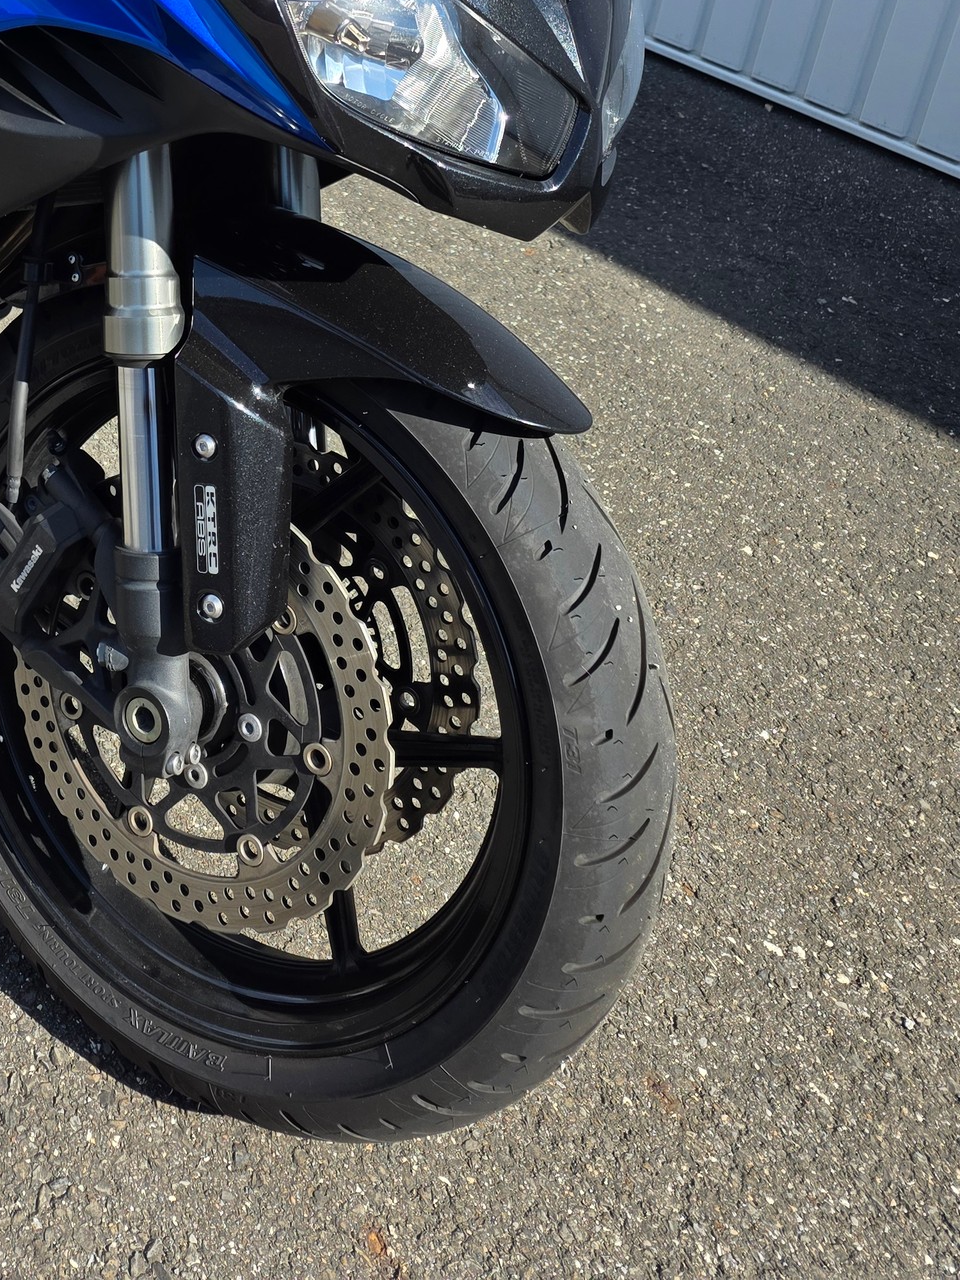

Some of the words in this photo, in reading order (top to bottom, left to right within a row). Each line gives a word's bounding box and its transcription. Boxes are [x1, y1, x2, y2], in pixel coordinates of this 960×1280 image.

[196, 501, 206, 557] ABS
[206, 490, 218, 568] KTRC
[10, 544, 44, 593] Kawasaki
[126, 1007, 229, 1072] BATTLAX
